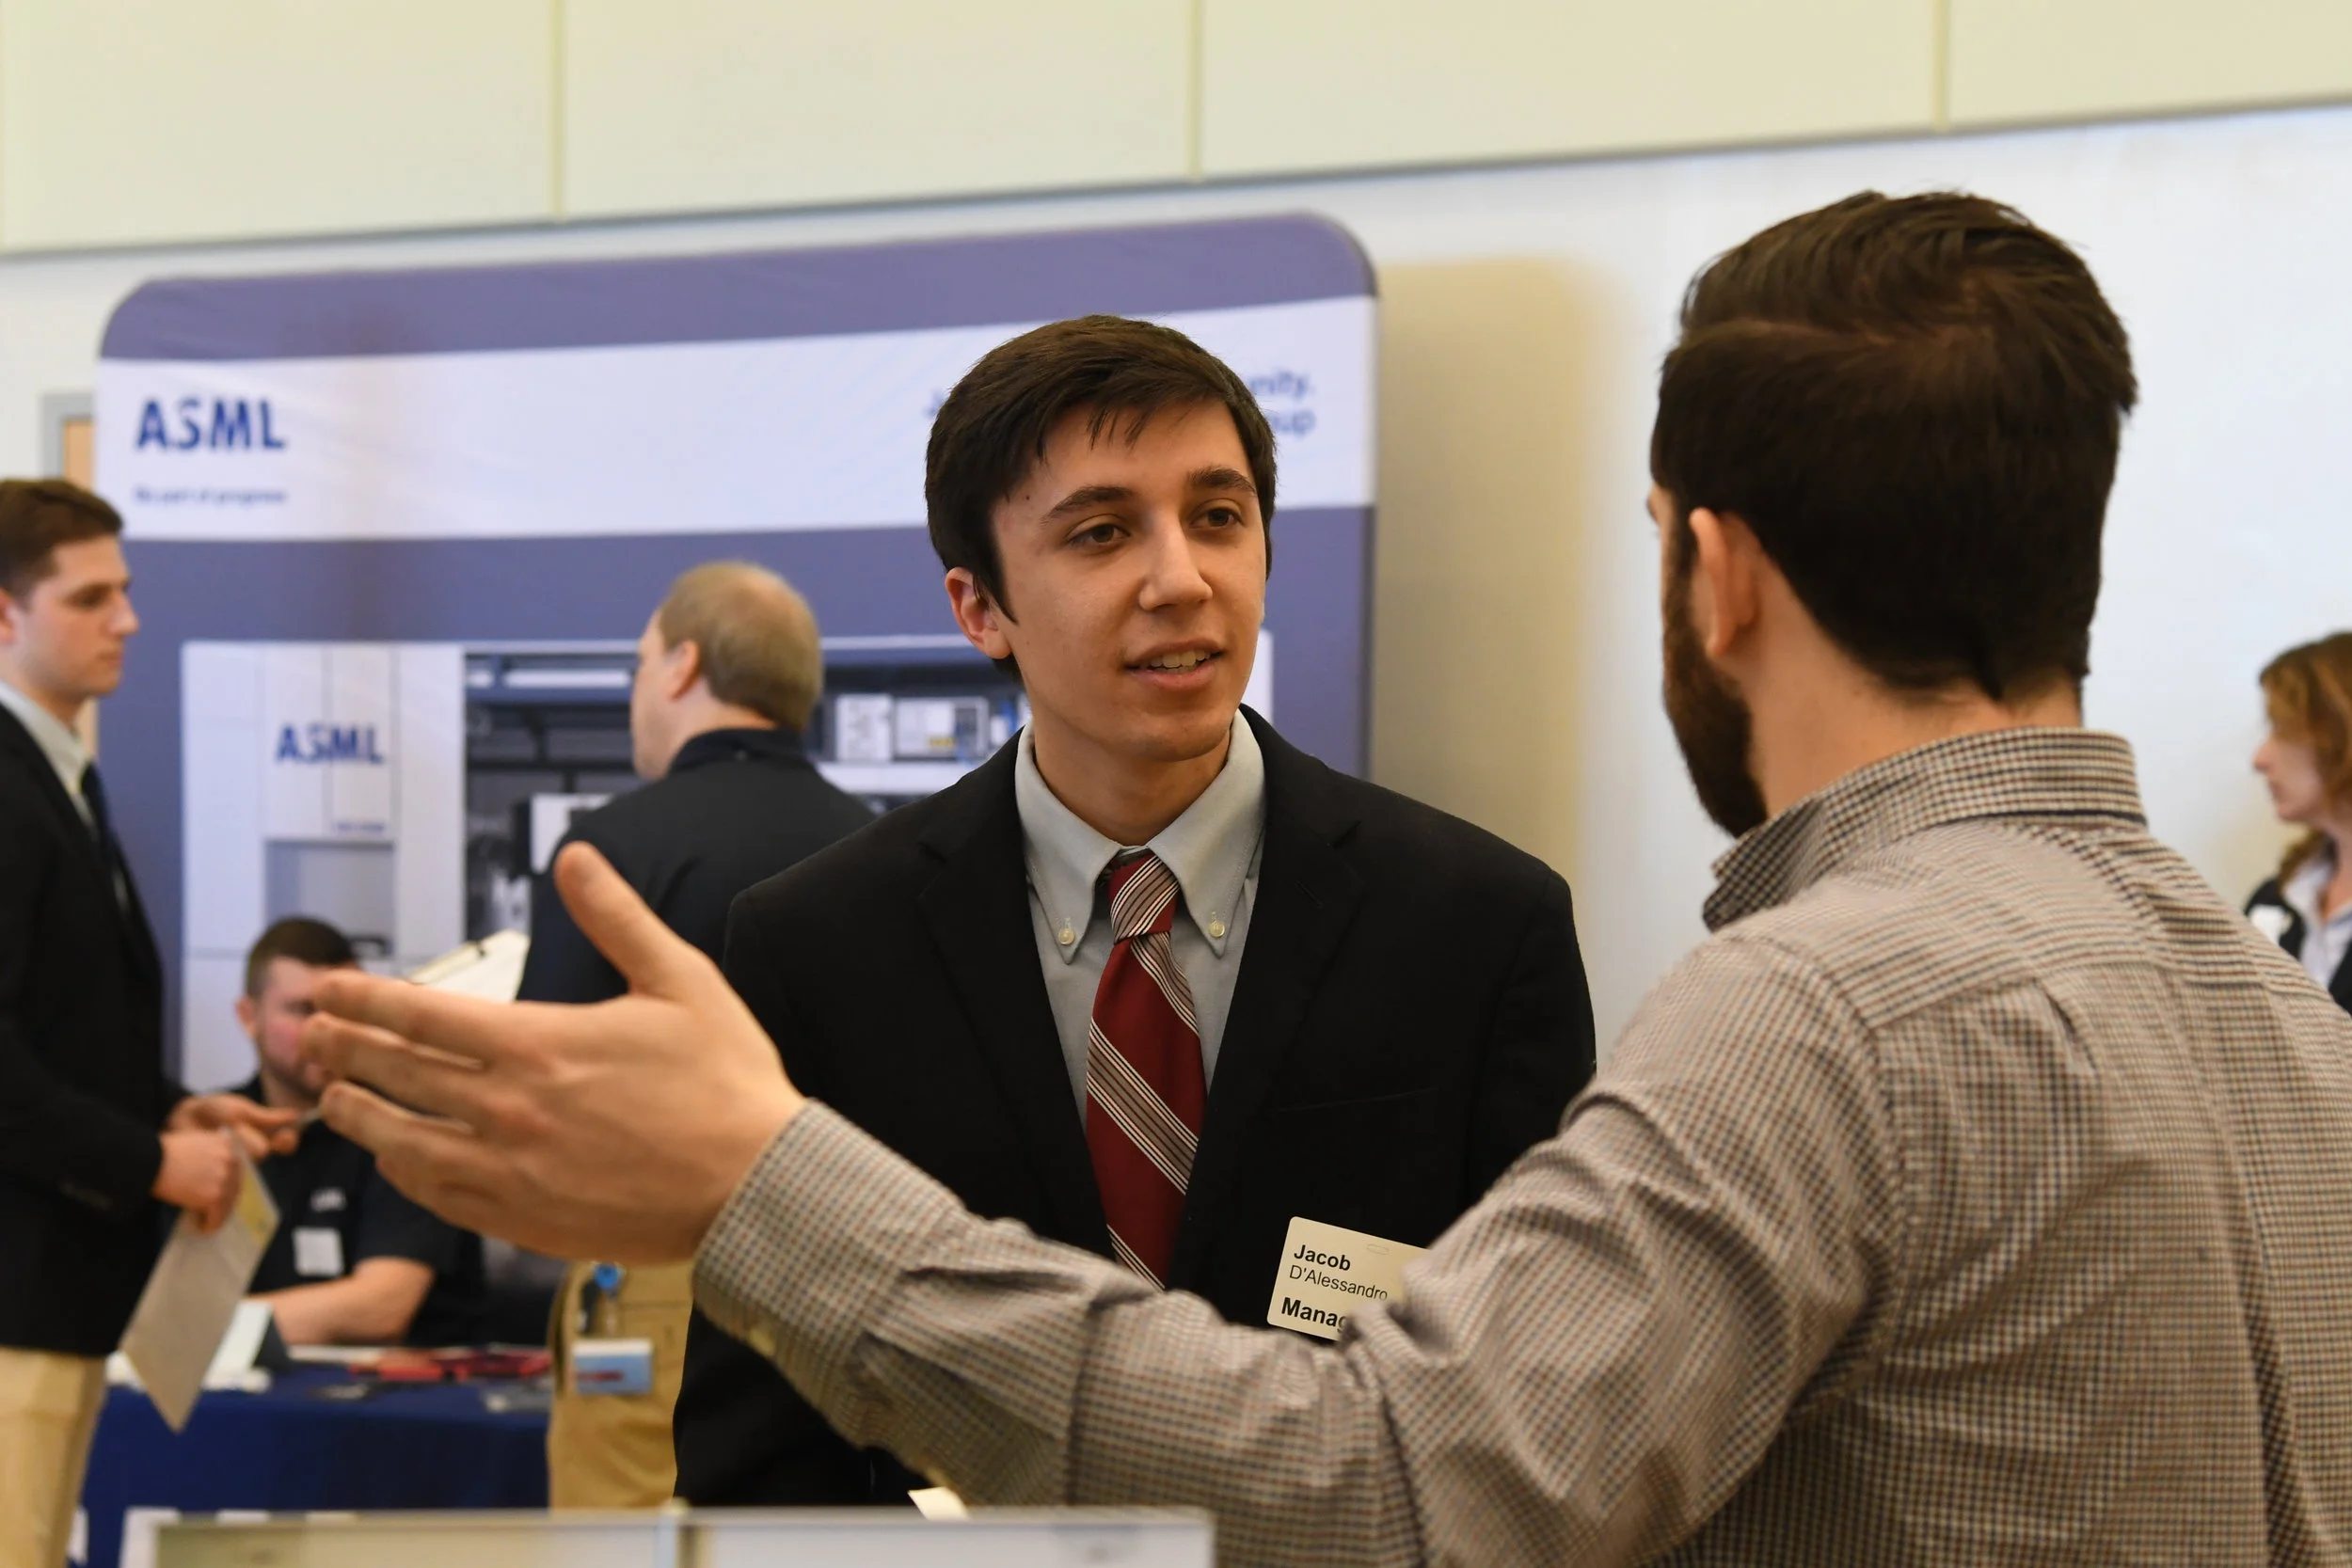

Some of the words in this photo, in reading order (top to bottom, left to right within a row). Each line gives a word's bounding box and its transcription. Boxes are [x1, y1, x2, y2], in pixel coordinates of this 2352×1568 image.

[137, 399, 285, 450] ASML
[277, 724, 386, 765] ASML
[1294, 1244, 1351, 1271] Jacob
[1289, 1264, 1388, 1301] D'Alessandro
